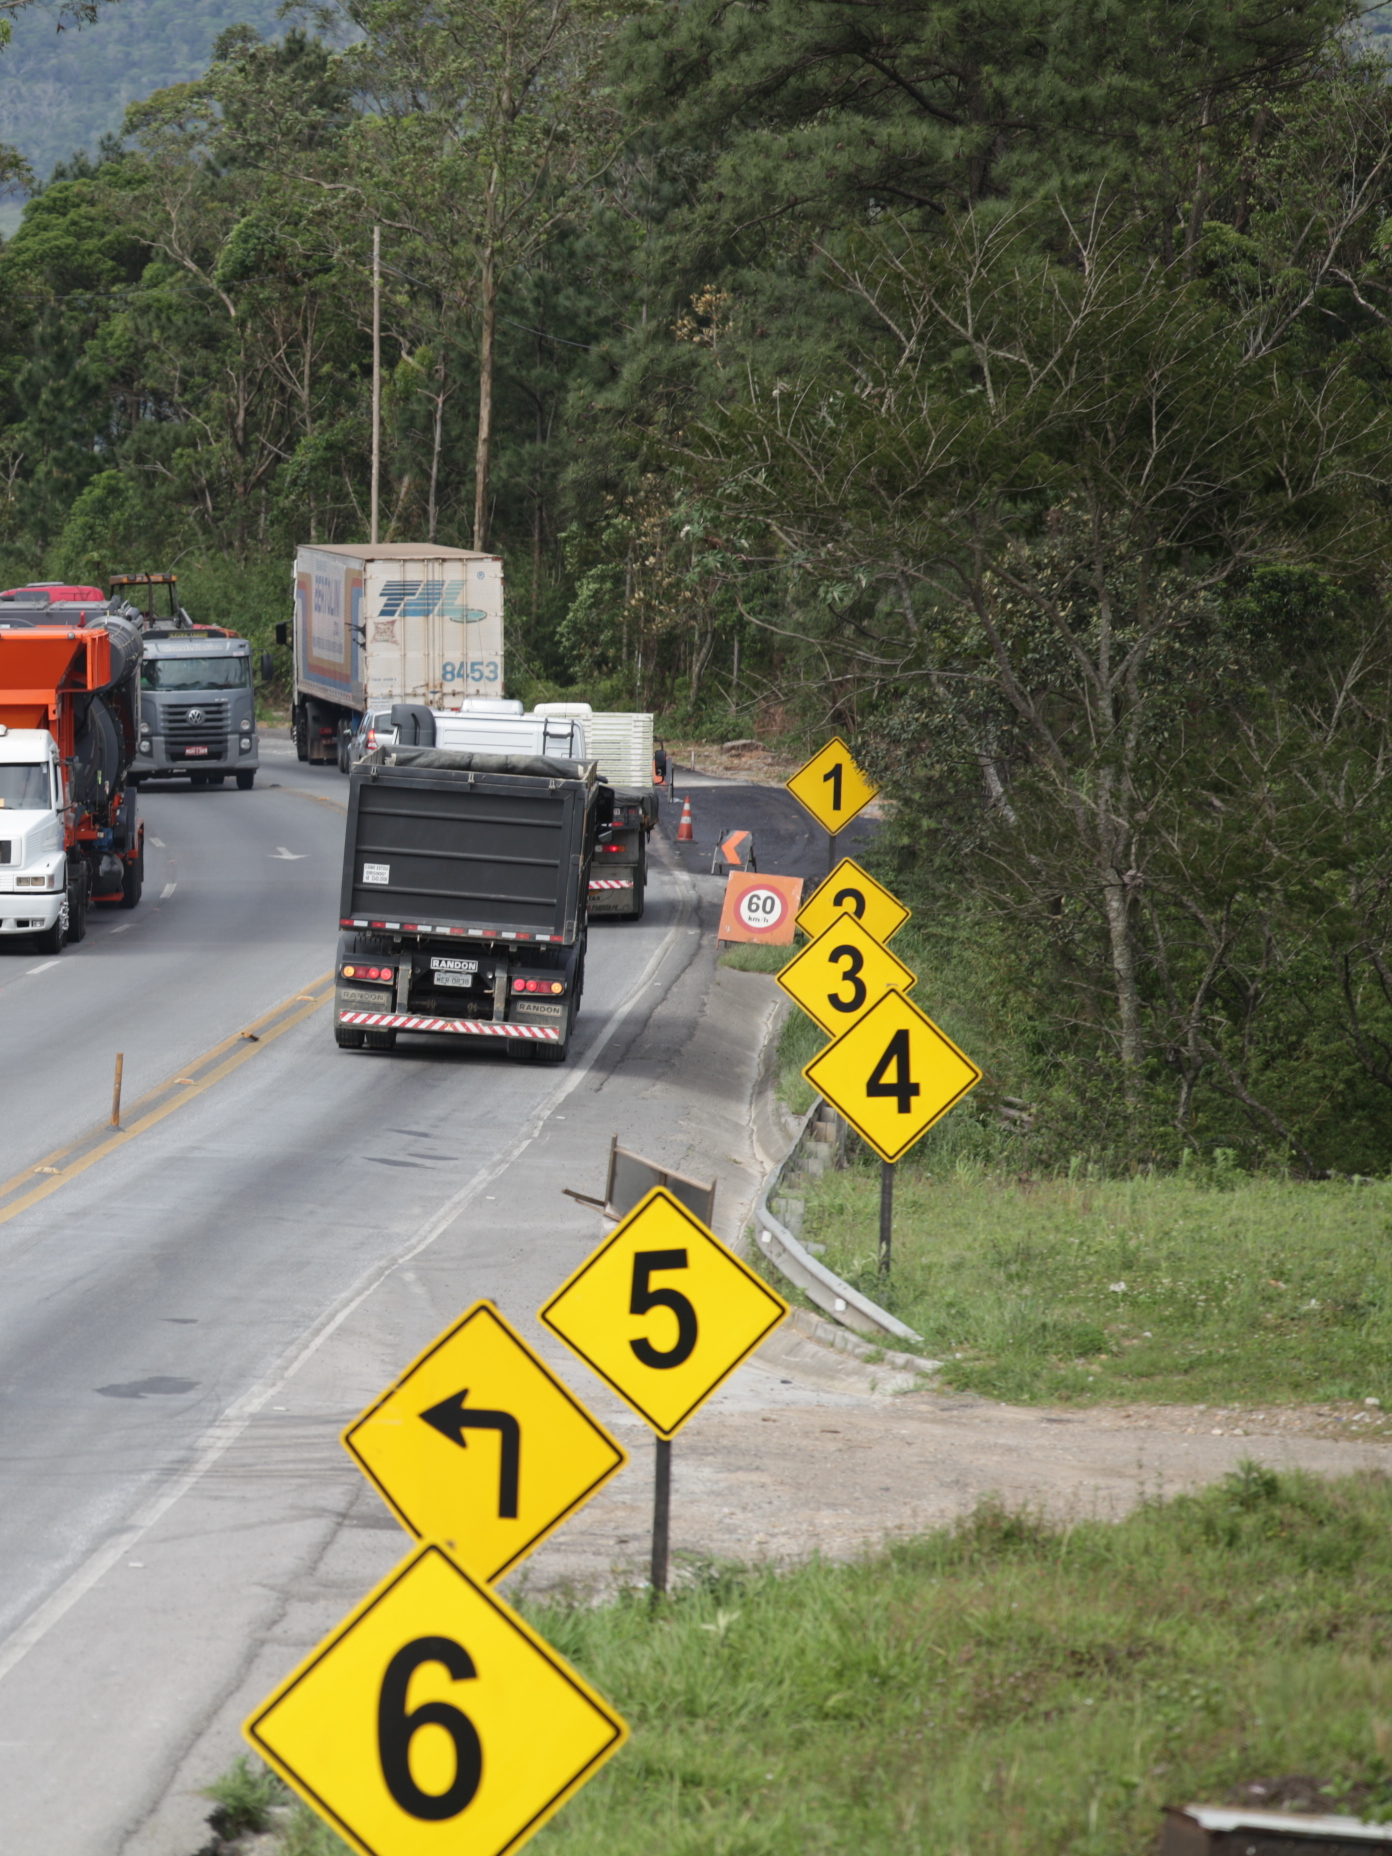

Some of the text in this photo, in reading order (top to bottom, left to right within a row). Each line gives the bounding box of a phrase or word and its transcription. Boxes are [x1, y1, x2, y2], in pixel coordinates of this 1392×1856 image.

[441, 661, 499, 683] 8453
[822, 763, 844, 811] 1
[747, 894, 776, 915] 60
[747, 915, 769, 923] km/h
[432, 959, 476, 970] RANDON
[827, 944, 867, 1013] 3
[343, 991, 384, 1002] RANDON
[518, 1003, 561, 1015] RANDON
[866, 1029, 920, 1114] 4
[629, 1248, 698, 1370] 5
[377, 1636, 484, 1822] 6
